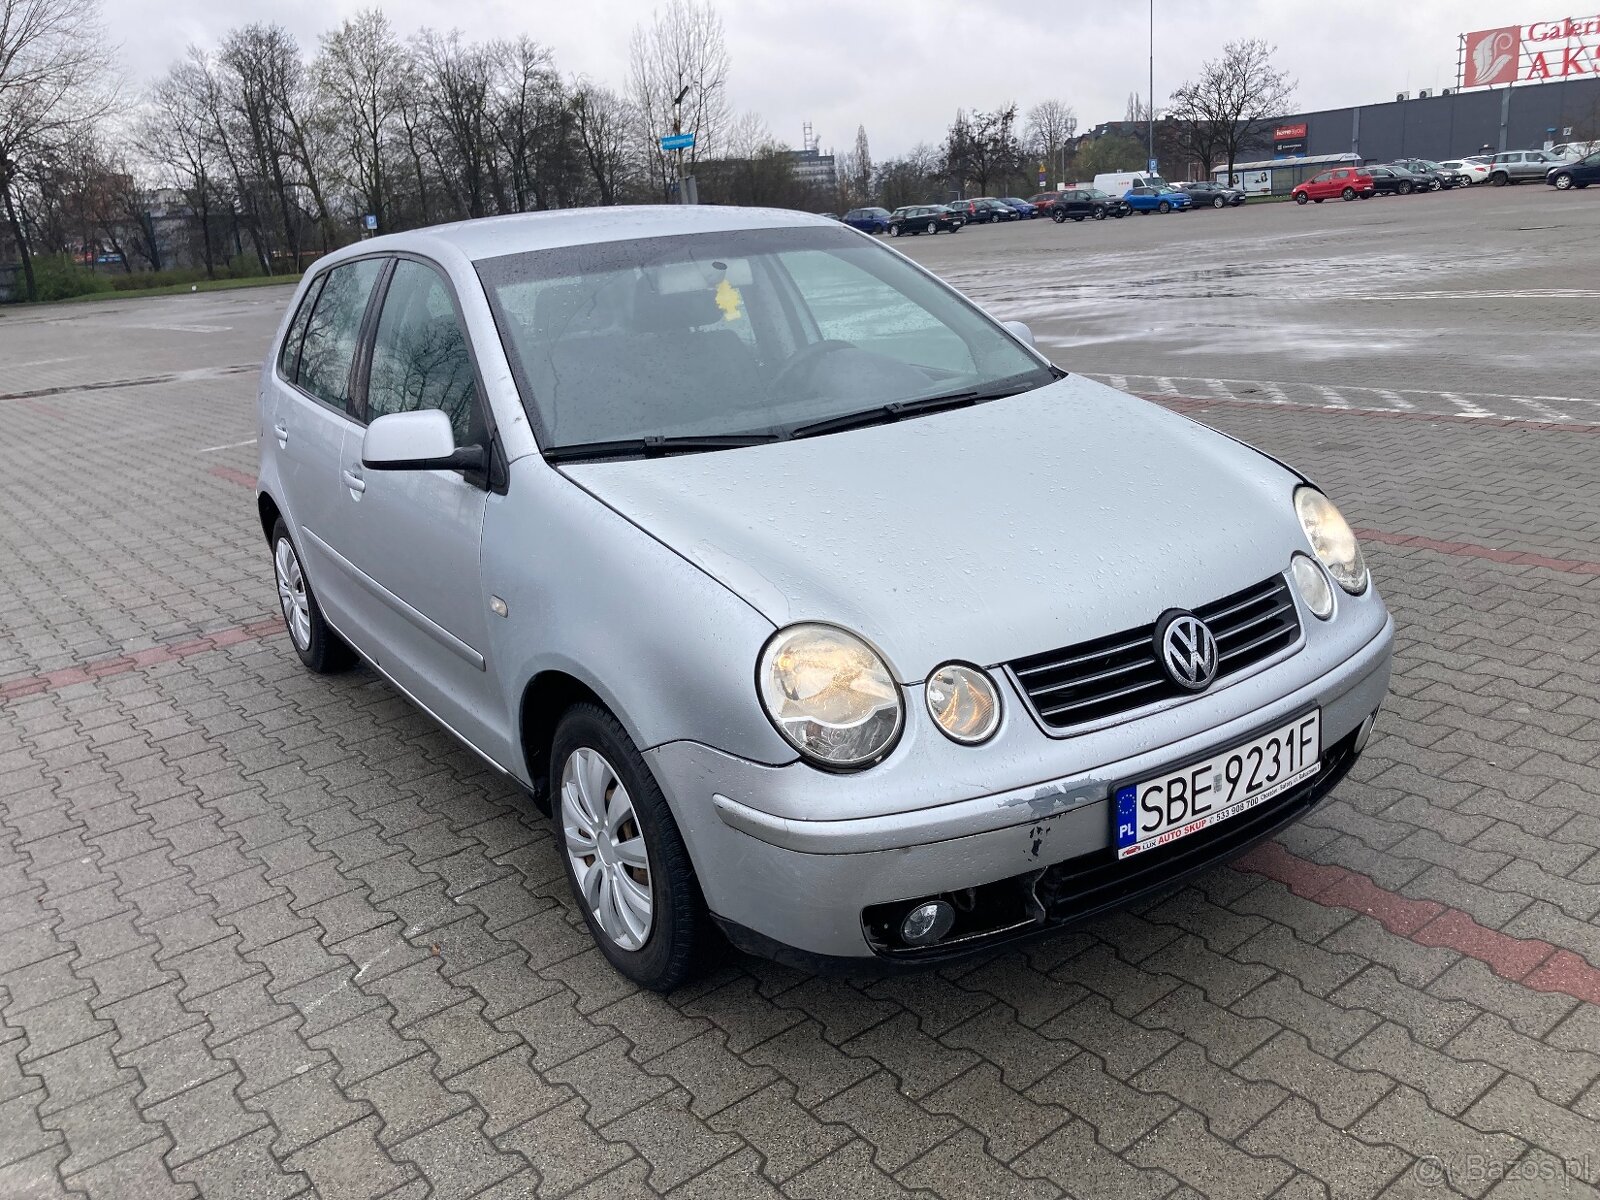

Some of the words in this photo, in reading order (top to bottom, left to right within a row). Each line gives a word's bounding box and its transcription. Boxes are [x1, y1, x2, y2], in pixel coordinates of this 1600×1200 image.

[1141, 764, 1213, 832] SBE
[1225, 716, 1316, 802] 9231F
[1119, 823, 1135, 839] PL
[1158, 829, 1182, 844] AUTO
[1184, 819, 1207, 834] SKUP
[1216, 809, 1230, 822] 533
[1246, 796, 1259, 808] 700
